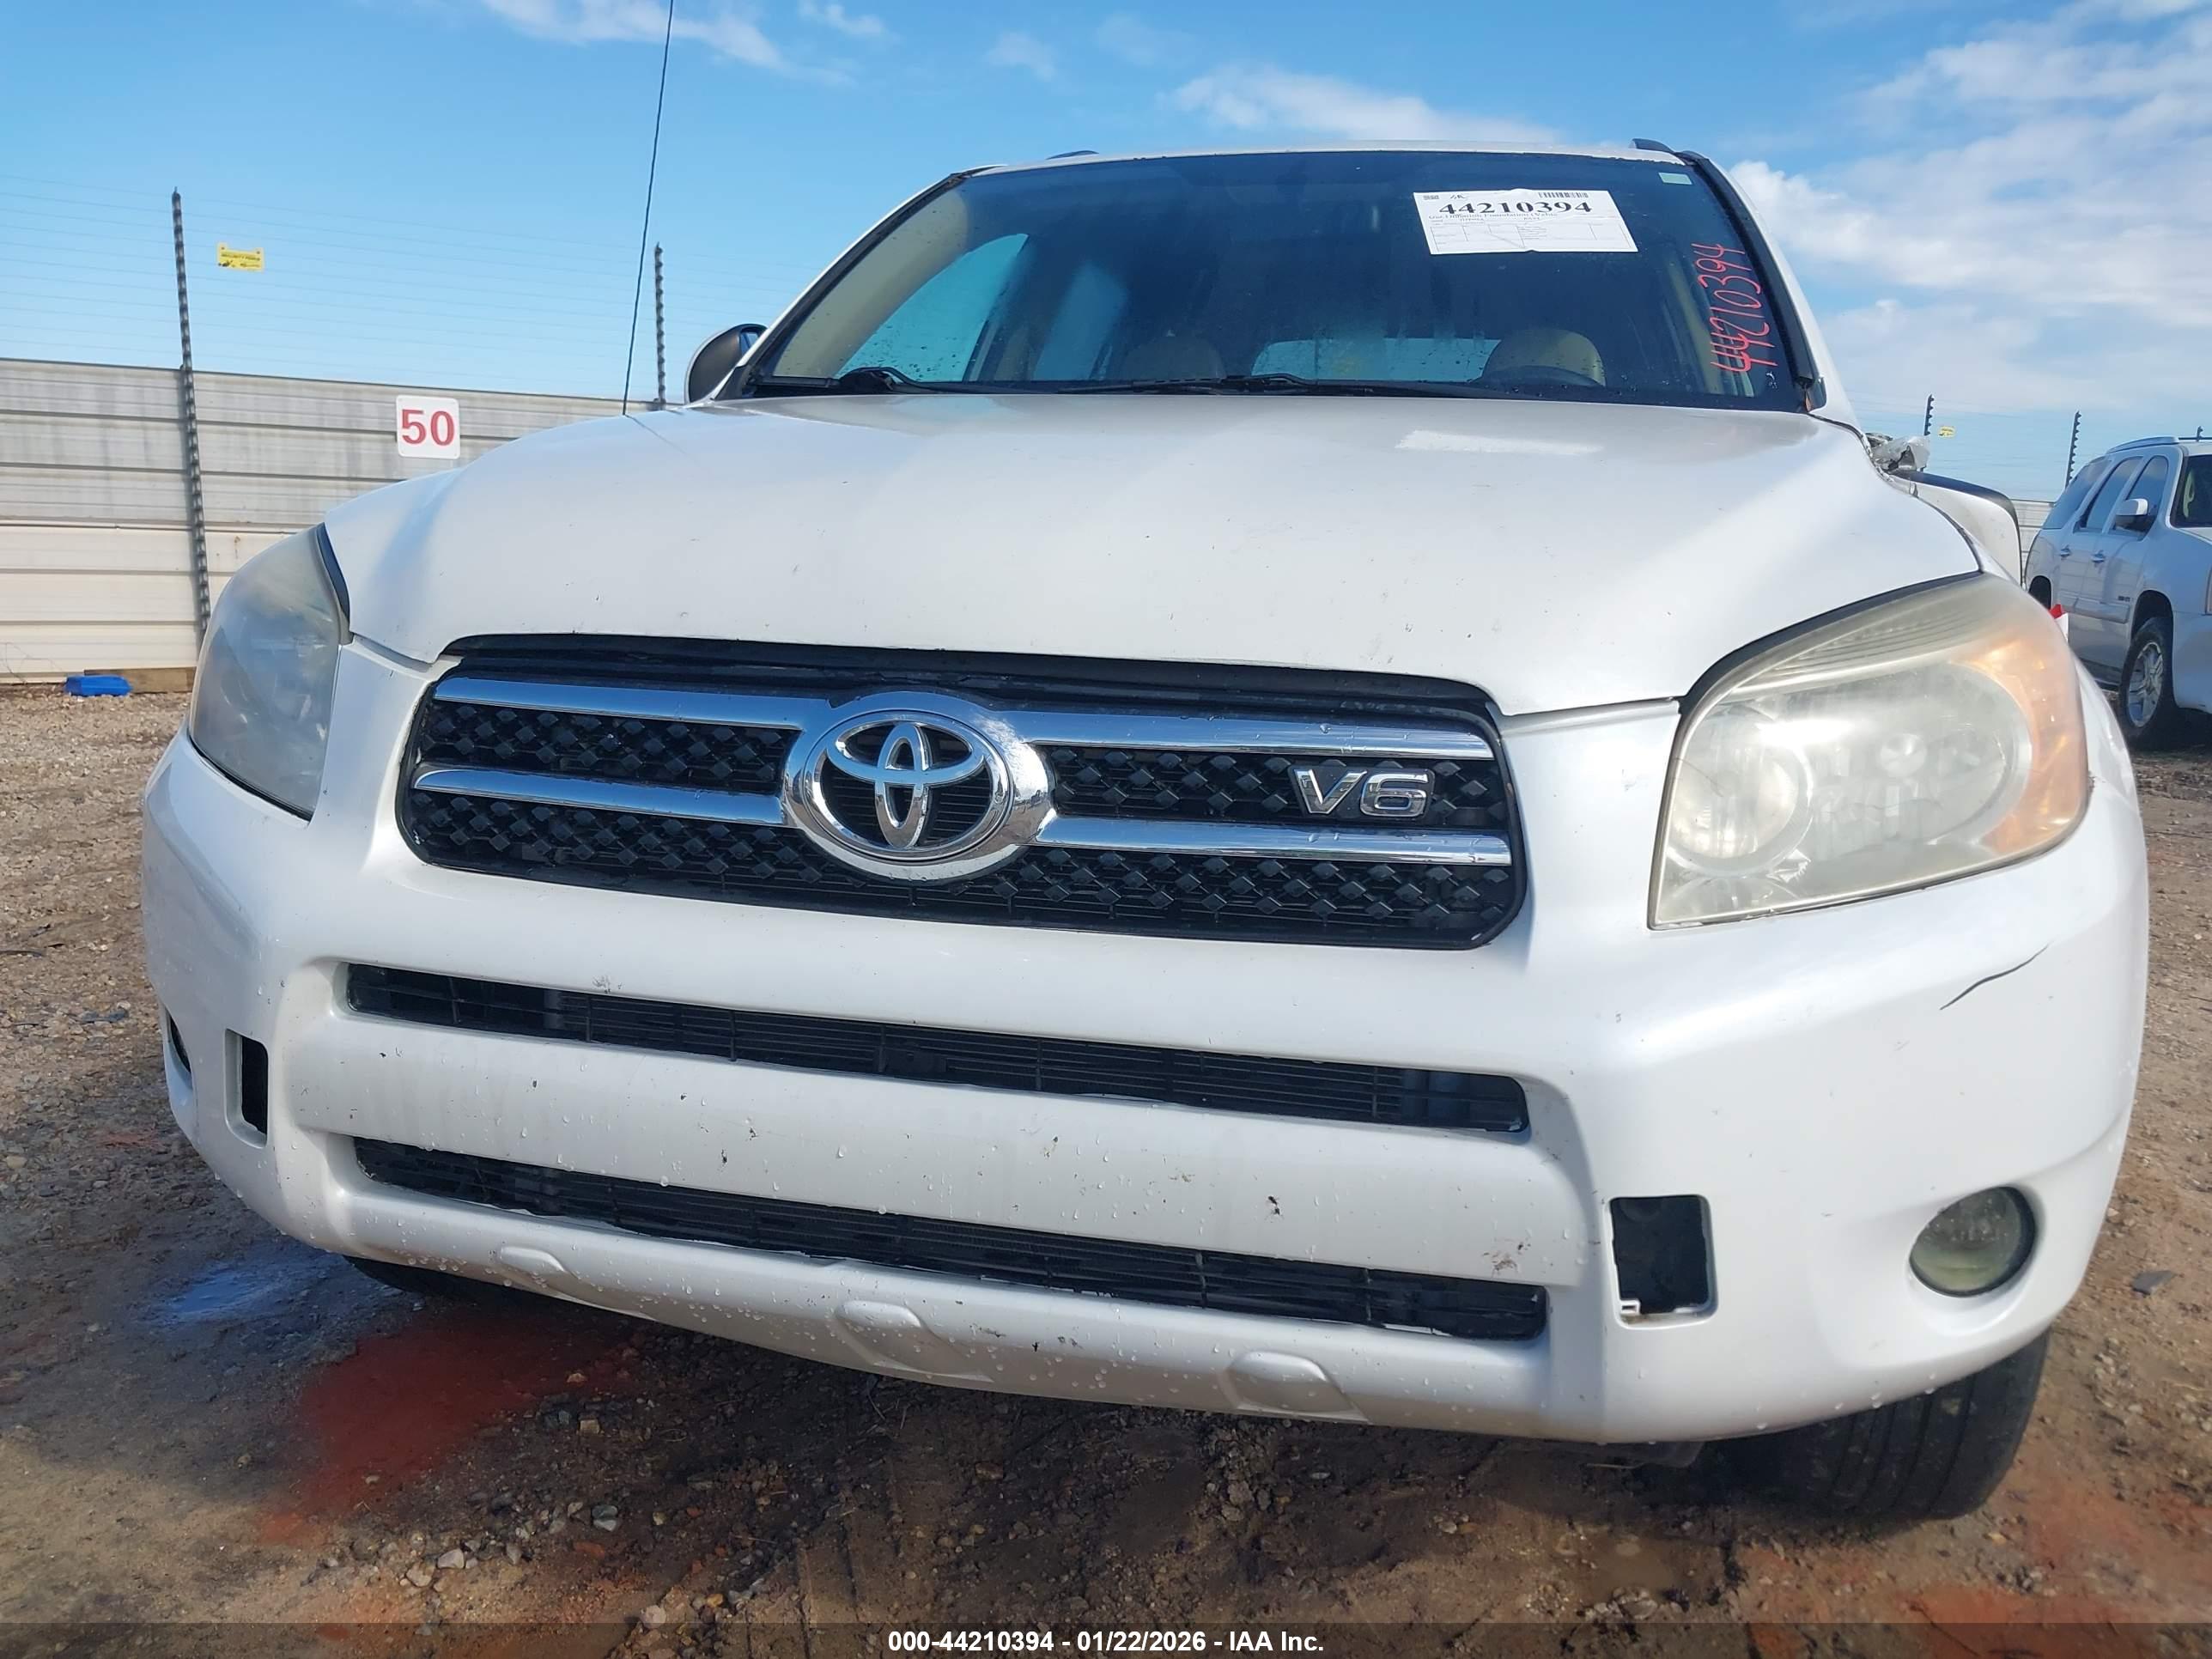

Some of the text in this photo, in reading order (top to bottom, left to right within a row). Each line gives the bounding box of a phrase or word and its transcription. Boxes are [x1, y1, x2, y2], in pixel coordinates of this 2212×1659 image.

[1439, 201, 1592, 214] 44210394
[1691, 242, 1778, 373] 44210394
[401, 409, 455, 446] 50
[1294, 769, 1429, 817] V6
